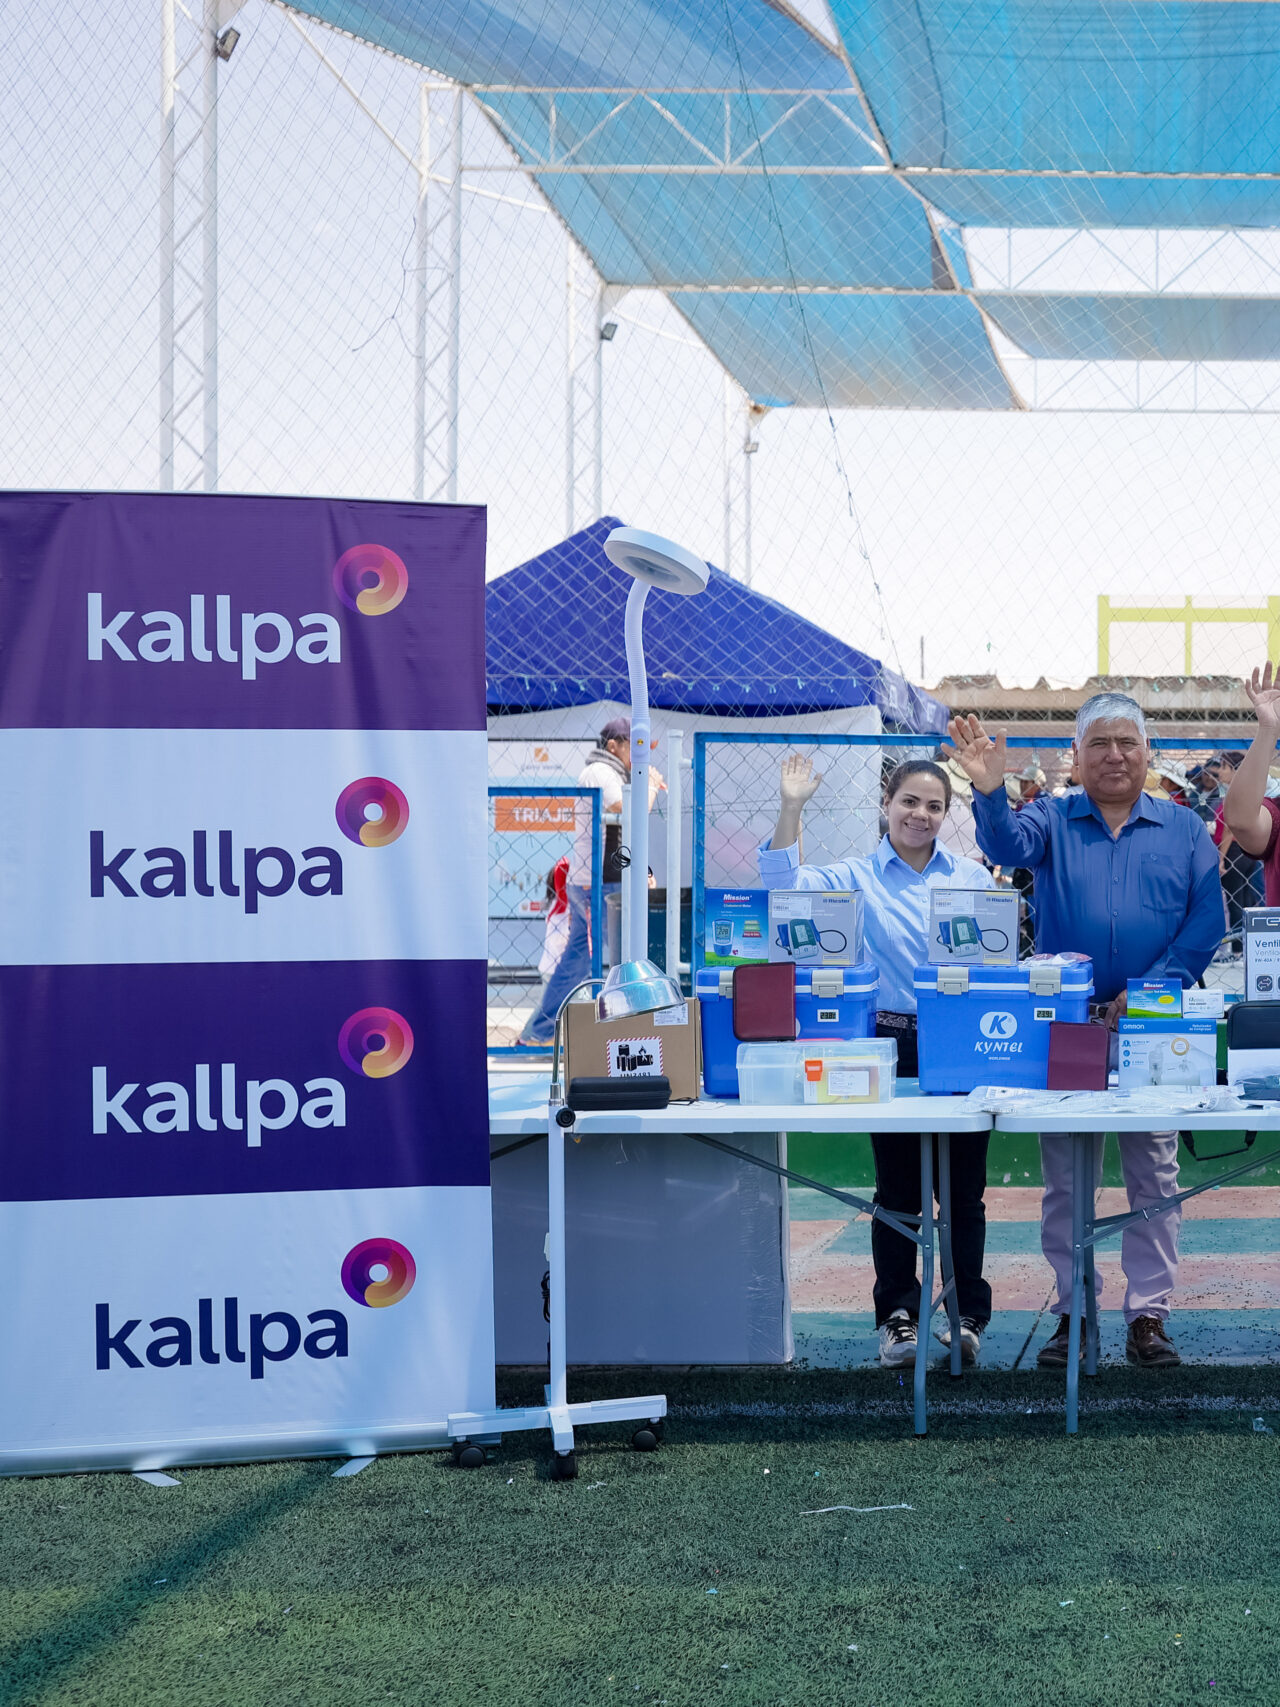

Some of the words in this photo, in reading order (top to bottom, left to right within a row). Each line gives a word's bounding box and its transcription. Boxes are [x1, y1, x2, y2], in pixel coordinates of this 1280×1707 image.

[88, 593, 341, 680] kallpa
[512, 807, 573, 823] TRIAJE
[90, 830, 343, 914] kallpa
[974, 1041, 1024, 1054] KYNTEL
[988, 1015, 1008, 1034] K
[93, 1063, 345, 1147] kallpa
[96, 1297, 348, 1379] kallpa
